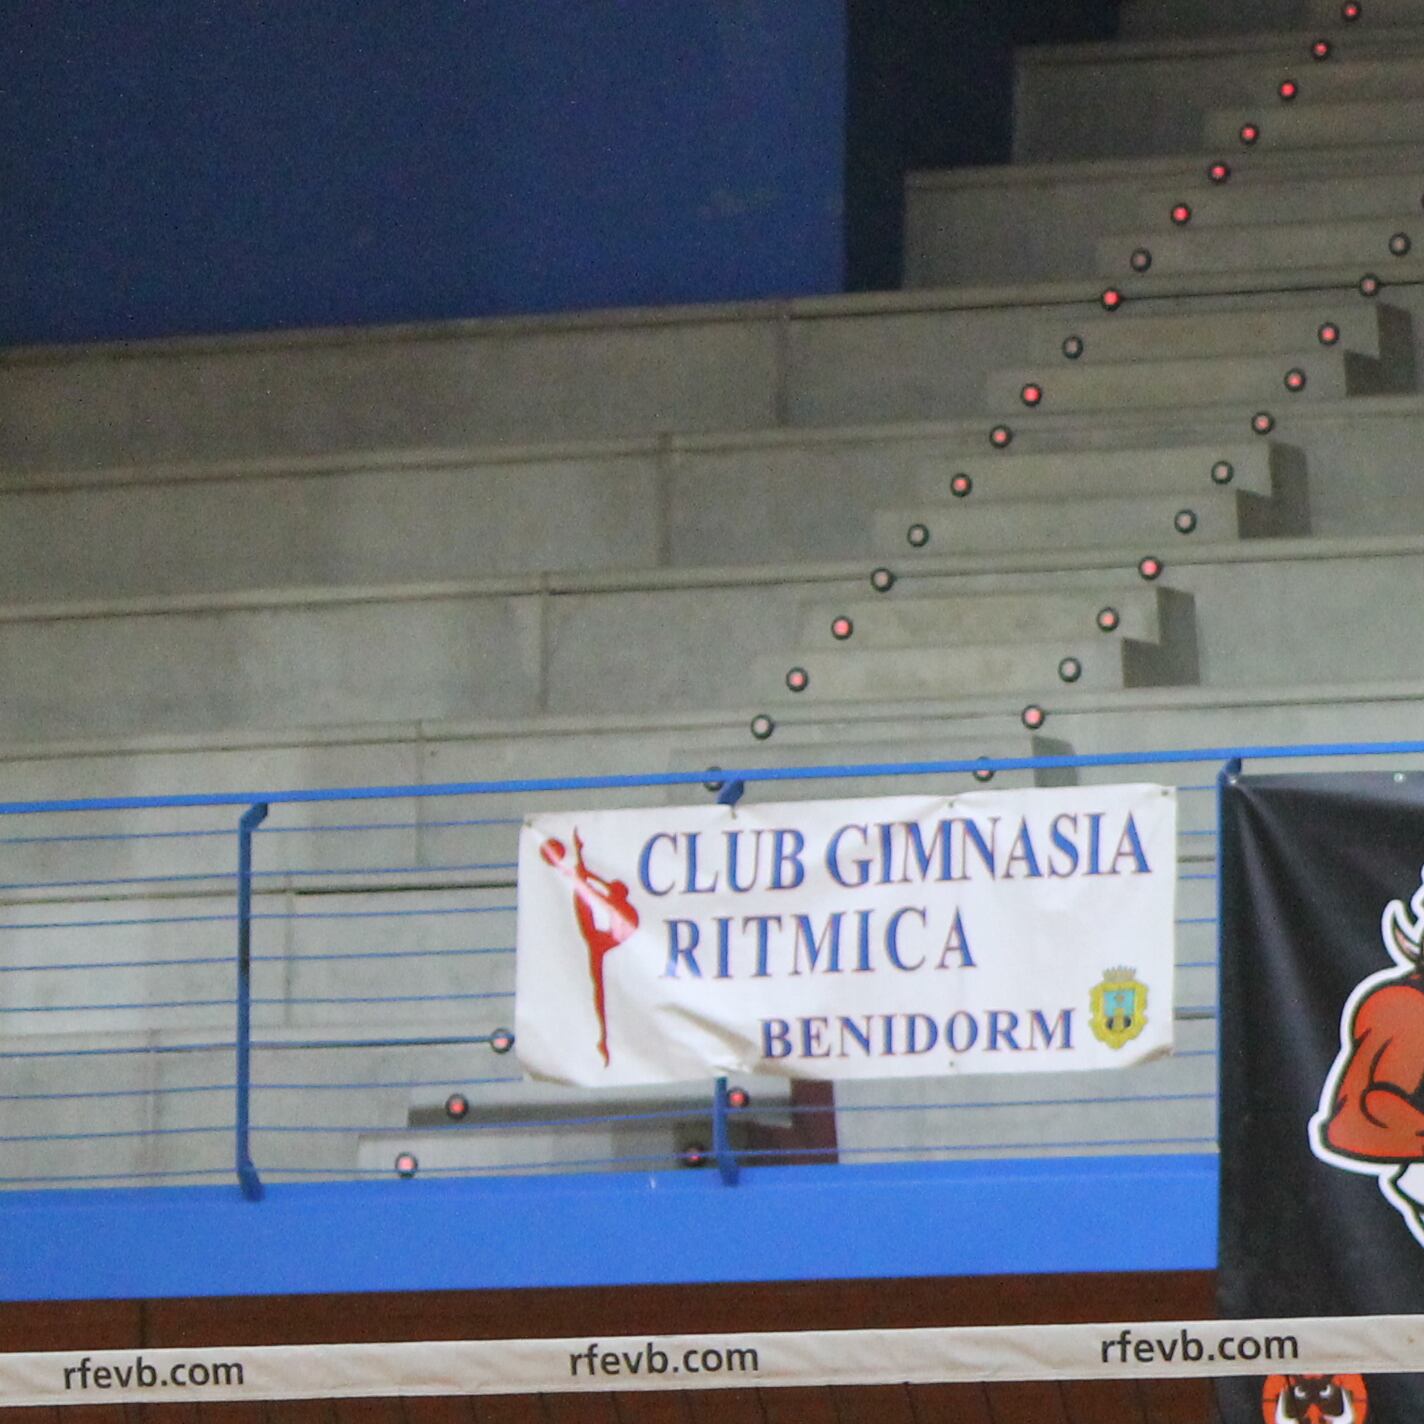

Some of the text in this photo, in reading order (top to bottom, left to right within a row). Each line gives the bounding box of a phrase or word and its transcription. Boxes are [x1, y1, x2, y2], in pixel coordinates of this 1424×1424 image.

[638, 811, 1153, 896] CLUB GIMNASIA
[660, 906, 978, 980] RITMICA
[759, 1008, 1076, 1061] BENIDORM
[569, 1341, 760, 1378] rfevb.com
[1101, 1329, 1299, 1365] rfevb.com
[63, 1355, 245, 1391] rfevb.com
